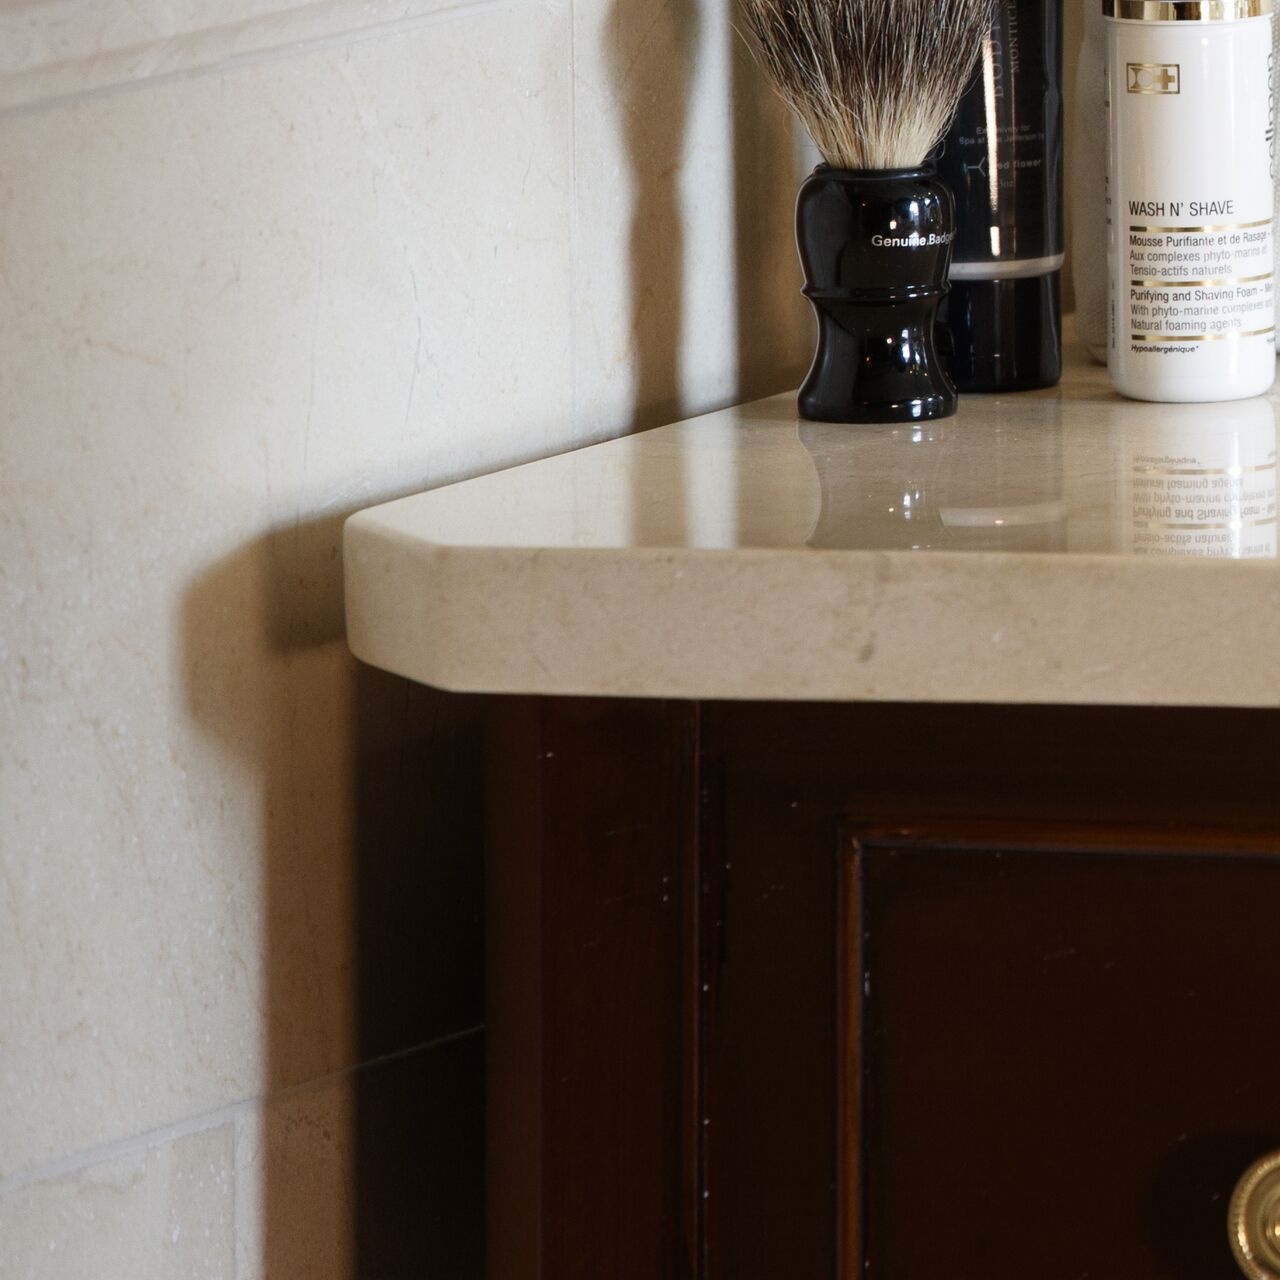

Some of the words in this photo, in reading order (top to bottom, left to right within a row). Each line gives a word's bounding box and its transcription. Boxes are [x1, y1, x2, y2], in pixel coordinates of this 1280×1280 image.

[959, 136, 975, 146] Spa
[1012, 159, 1041, 168] flower
[1128, 201, 1165, 217] WASH
[1189, 200, 1234, 217] SHAVE
[1129, 235, 1163, 247] Mousse
[1166, 236, 1214, 247] Purifiante
[1217, 234, 1227, 245] et
[1229, 233, 1241, 244] de
[1243, 231, 1267, 243] Rasage
[1129, 250, 1145, 261] Aux
[1146, 252, 1200, 263] complexes
[1203, 247, 1261, 263] phyto-marins
[1130, 264, 1188, 276] Tensio-actifs
[1191, 264, 1232, 276] naturels
[1130, 289, 1169, 303] Purifying
[1172, 291, 1191, 302] and
[1194, 288, 1234, 301] Shaving
[1236, 287, 1257, 298] Foam
[1130, 304, 1149, 316] With
[1152, 306, 1219, 318] phyto-marine
[1221, 301, 1264, 314] complexes
[1131, 319, 1162, 330] Natural
[1165, 320, 1207, 332] foaming
[1209, 318, 1242, 331] agents
